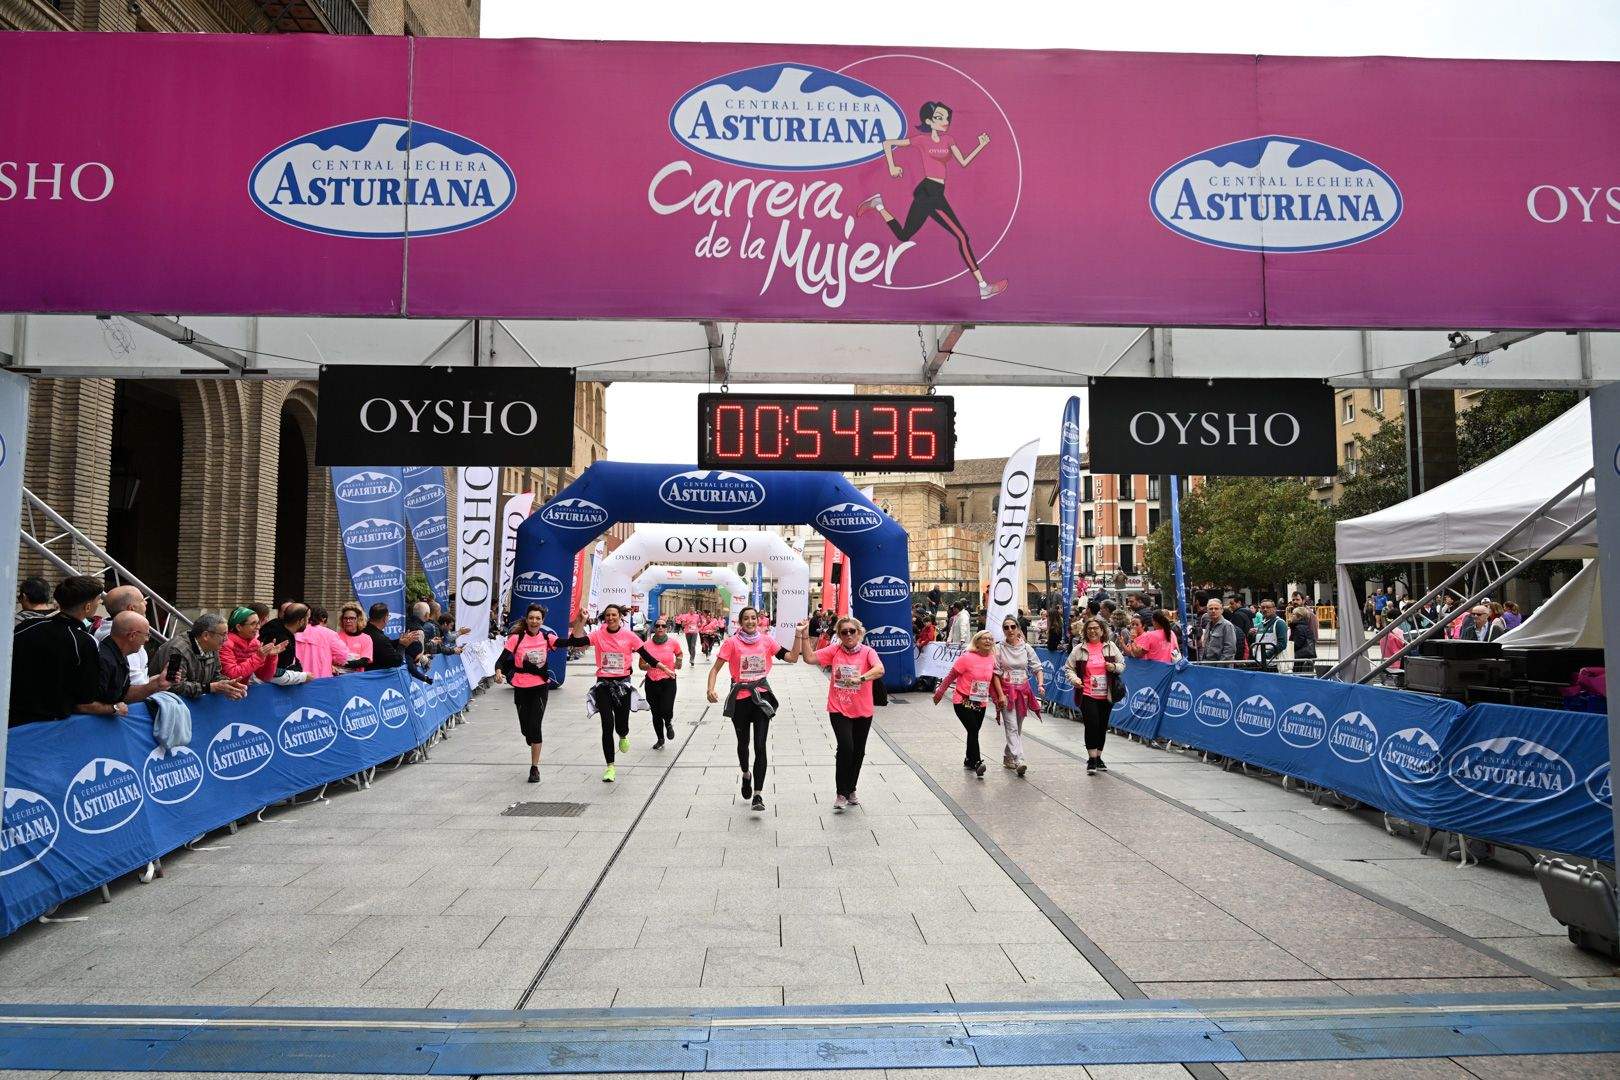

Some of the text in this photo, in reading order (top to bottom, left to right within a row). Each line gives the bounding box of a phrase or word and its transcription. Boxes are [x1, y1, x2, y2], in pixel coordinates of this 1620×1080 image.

[725, 99, 882, 113] CENTRAL LECHERA
[688, 100, 888, 145] ASTURIANA
[312, 159, 488, 172] CENTRAL LECHERA
[0, 161, 114, 202] SHO
[268, 161, 496, 207] ASTURIANA
[648, 160, 844, 220] Carrera
[1208, 176, 1376, 188] CENTRAL LECHERA
[1170, 178, 1385, 222] ASTURIANA
[694, 215, 917, 309] de la Mujer
[359, 398, 538, 436] OYSHO
[1129, 411, 1301, 447] OYSHO
[666, 482, 758, 504] ASTURIANA
[545, 508, 604, 523] ASTURIANA
[822, 514, 879, 526] ASTURIANA
[461, 467, 494, 607] OYSHO
[665, 536, 747, 554] OYSHO
[994, 470, 1030, 606] OYSHO
[862, 586, 907, 598] ASTURIANA
[1196, 699, 1229, 720] ASTURIANA
[1237, 707, 1272, 729] ASTURIANA
[284, 725, 335, 749] ASTURIANA
[1279, 716, 1322, 740] ASTURIANA
[213, 742, 270, 773] ASTURIANA
[149, 763, 201, 794] ASTURIANA
[1455, 755, 1564, 792] ASTURIANA
[73, 783, 142, 824] ASTURIANA
